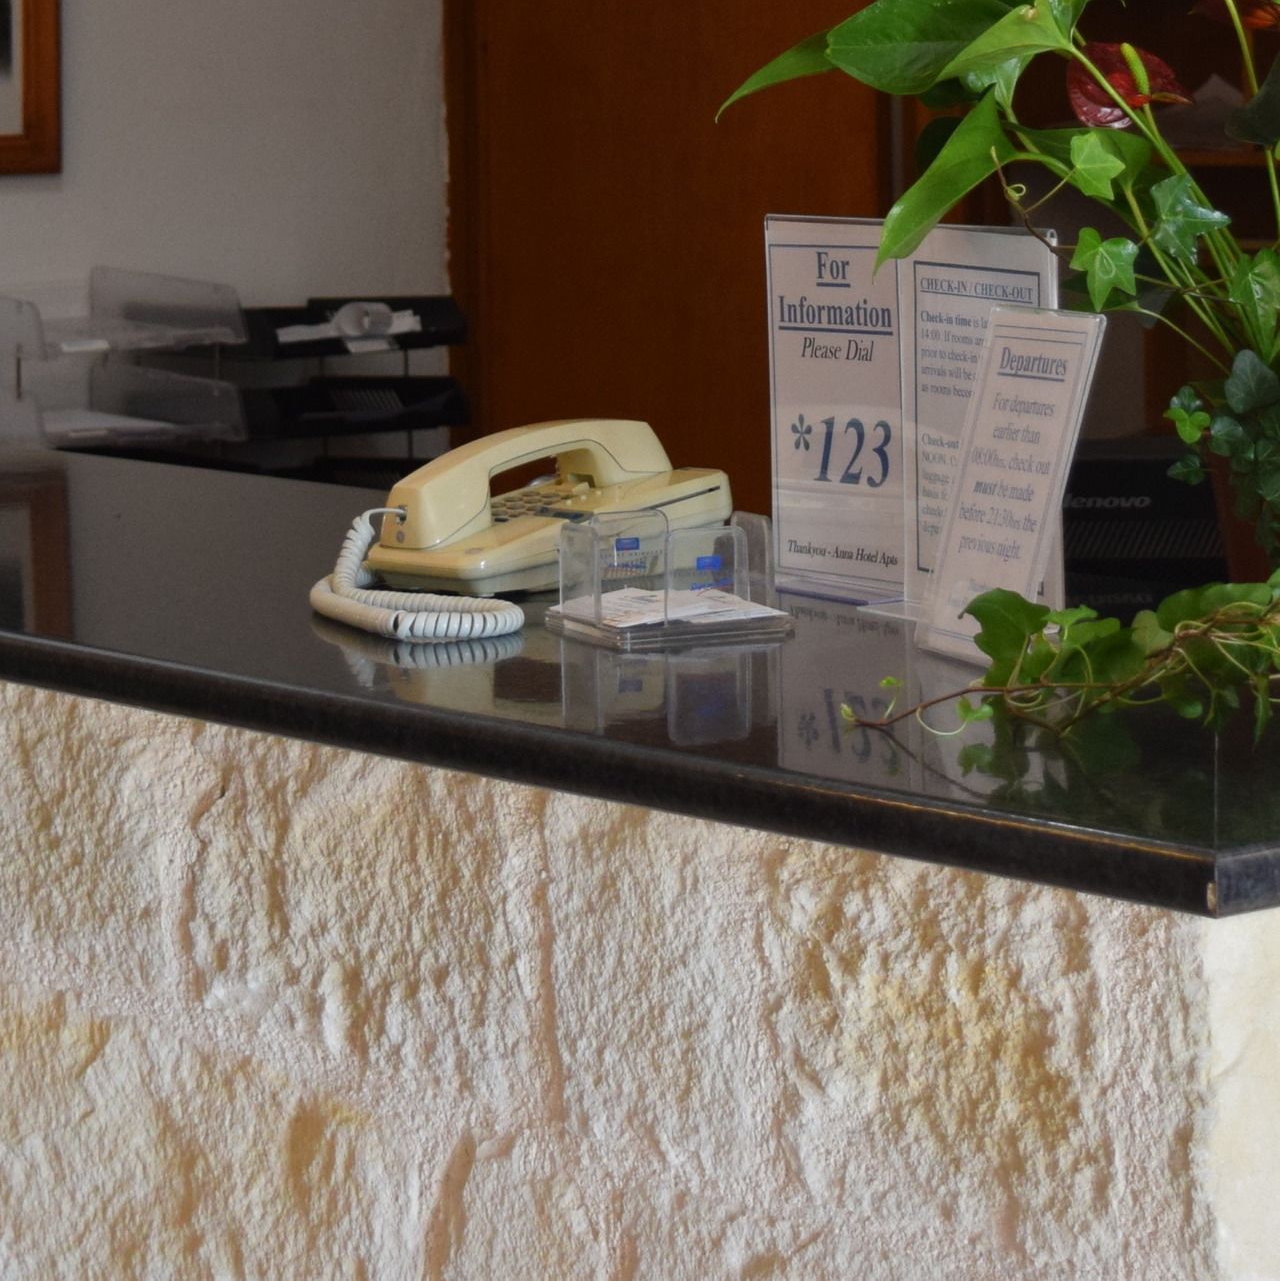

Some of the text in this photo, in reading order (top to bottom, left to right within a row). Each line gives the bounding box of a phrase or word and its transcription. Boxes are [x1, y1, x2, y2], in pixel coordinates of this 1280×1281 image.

[816, 250, 850, 281] For
[920, 277, 967, 293] CHECK-IN
[974, 282, 1034, 301] CHECK-OUT
[778, 295, 893, 329] Information
[920, 310, 954, 325] Check-in
[954, 314, 972, 328] time
[801, 335, 874, 363] Please Dial
[951, 334, 974, 346] rooms
[999, 345, 1069, 377] Departures
[992, 391, 1056, 418] For departures
[921, 432, 960, 450] Check-out
[991, 422, 1042, 445] earlier than
[1008, 452, 1034, 474] check
[1035, 459, 1051, 476] out
[972, 479, 1035, 502] must be made
[959, 502, 987, 524] before
[1022, 512, 1038, 533] the
[787, 539, 826, 560] Thankyou
[832, 546, 854, 560] Anna
[855, 547, 879, 564] Hotel
[879, 552, 899, 568] Apts
[957, 534, 996, 556] previous
